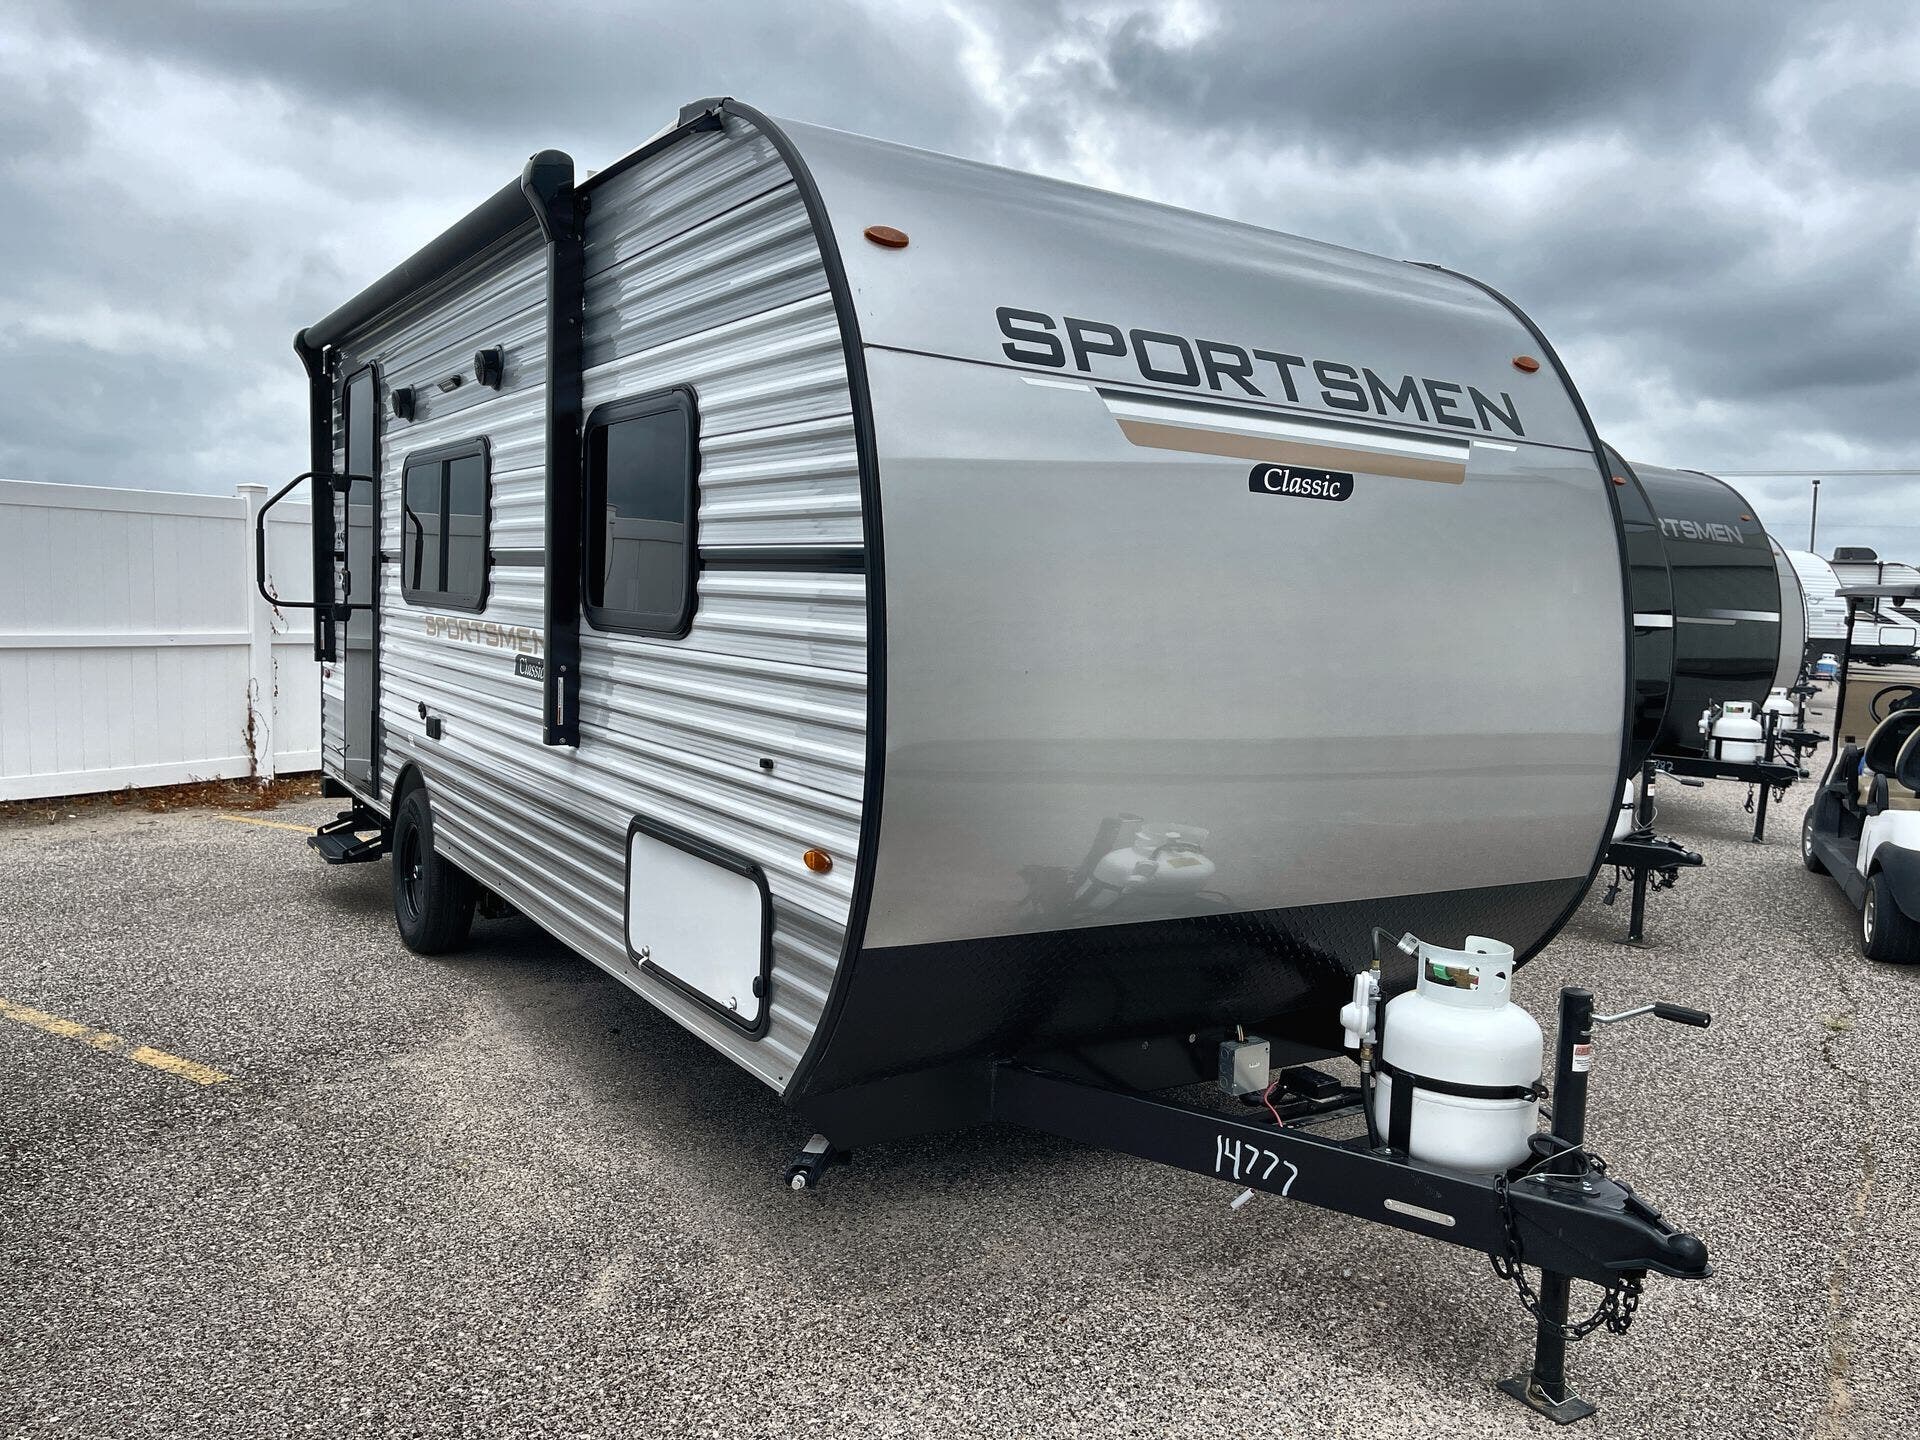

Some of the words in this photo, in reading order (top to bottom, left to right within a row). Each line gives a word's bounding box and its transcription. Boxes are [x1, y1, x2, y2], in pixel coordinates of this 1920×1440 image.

[996, 307, 1525, 437] SPORTSMEN
[1264, 468, 1341, 498] Classic
[1216, 1135, 1298, 1196] 14777
